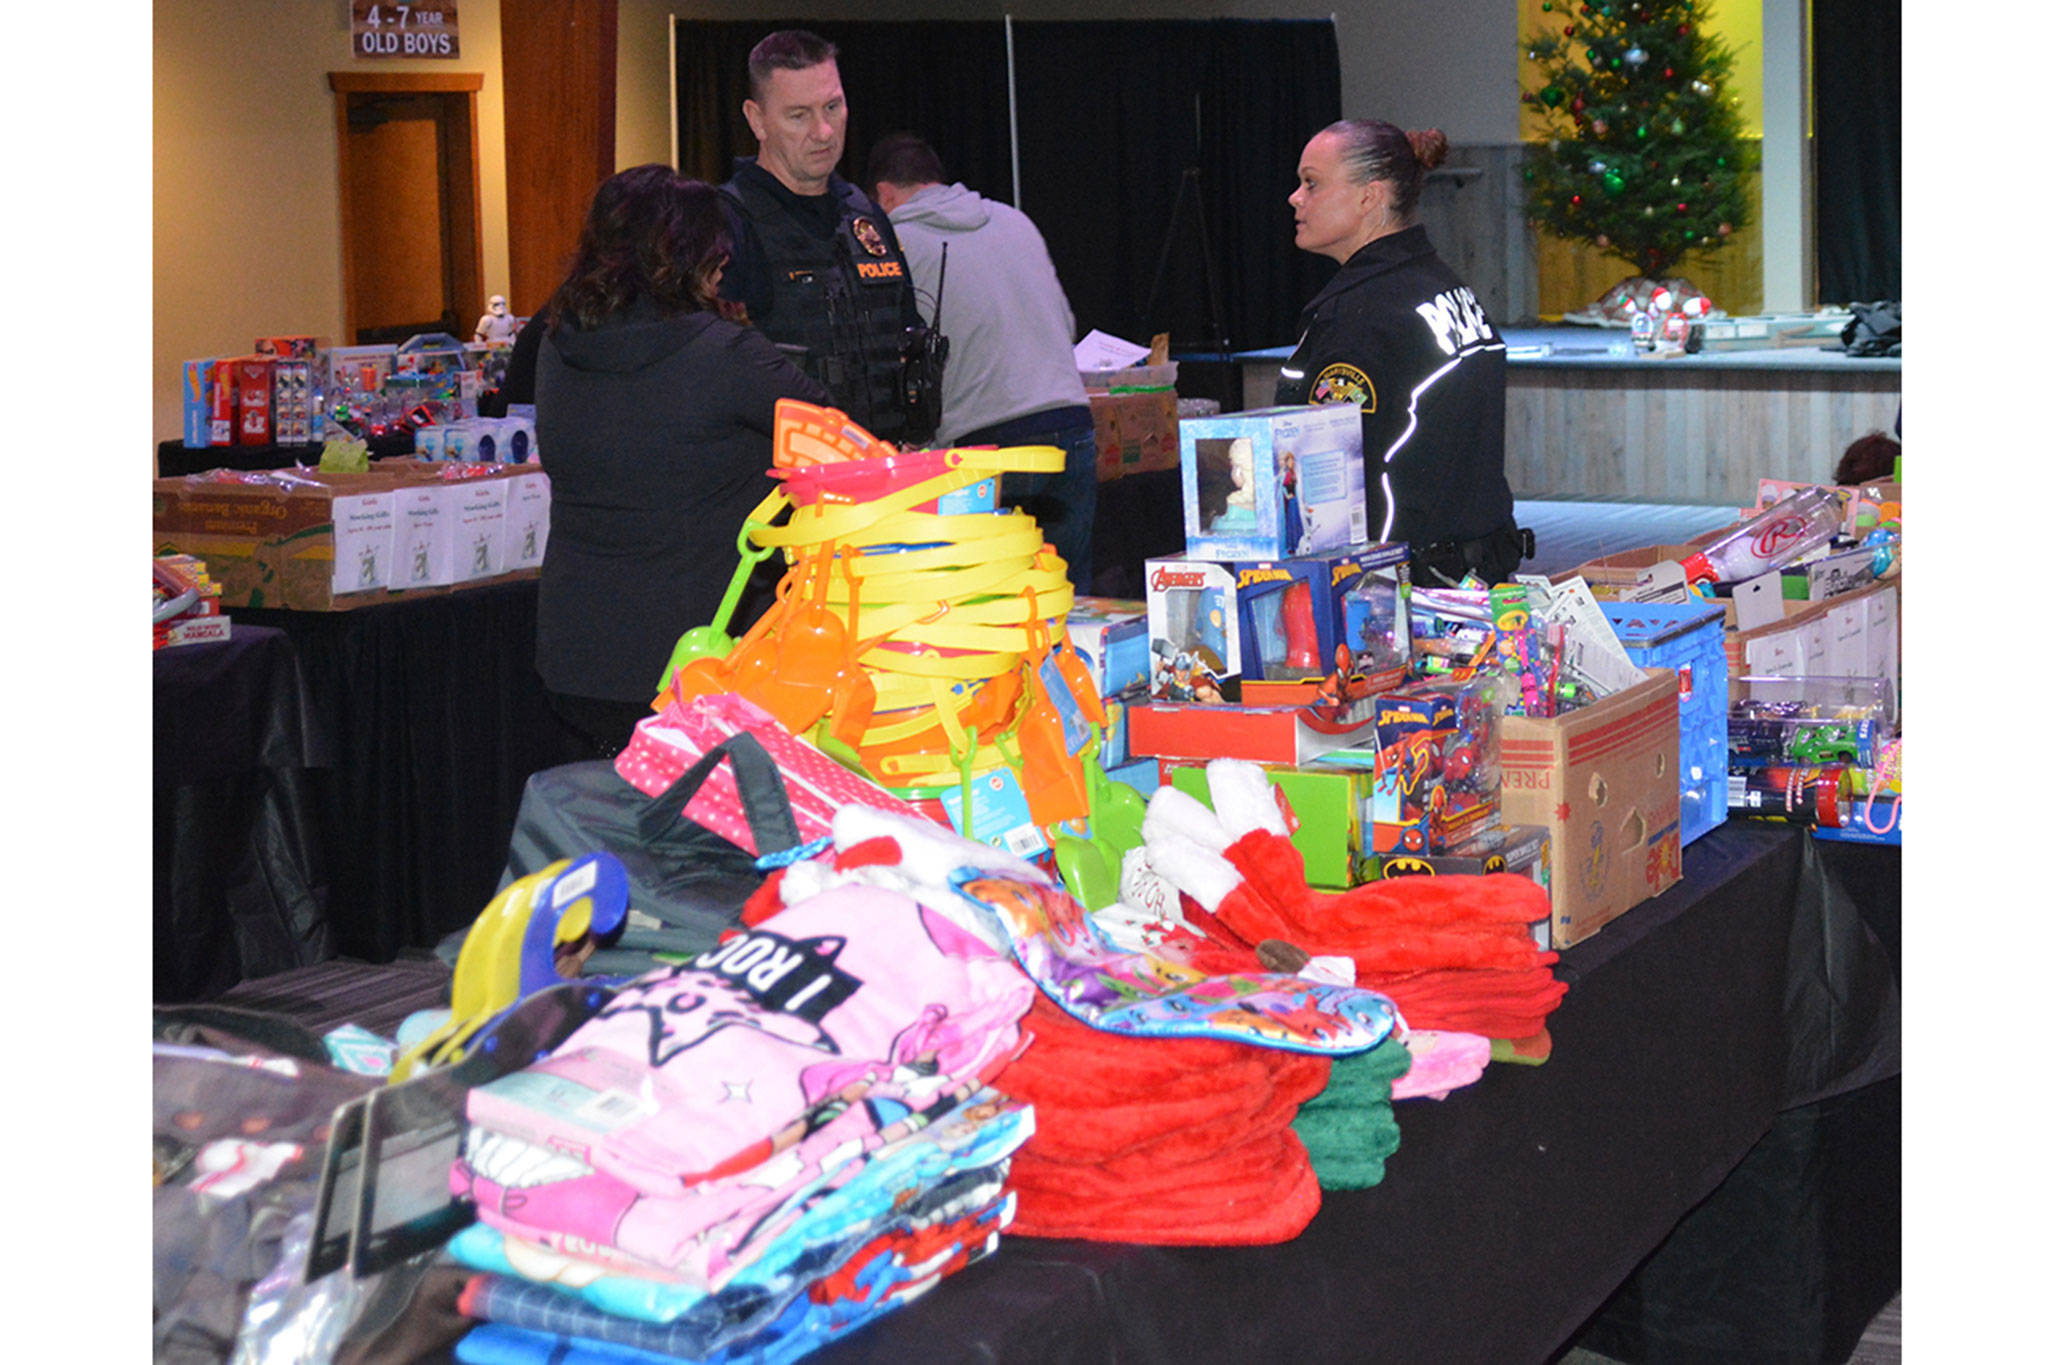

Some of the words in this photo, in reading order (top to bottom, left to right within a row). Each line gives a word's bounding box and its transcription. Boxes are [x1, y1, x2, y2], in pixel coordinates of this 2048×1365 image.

[366, 4, 381, 29] 4
[415, 11, 443, 24] YEAR
[362, 32, 399, 53] OLD
[404, 32, 451, 54] BOYS
[857, 262, 902, 278] POLICE
